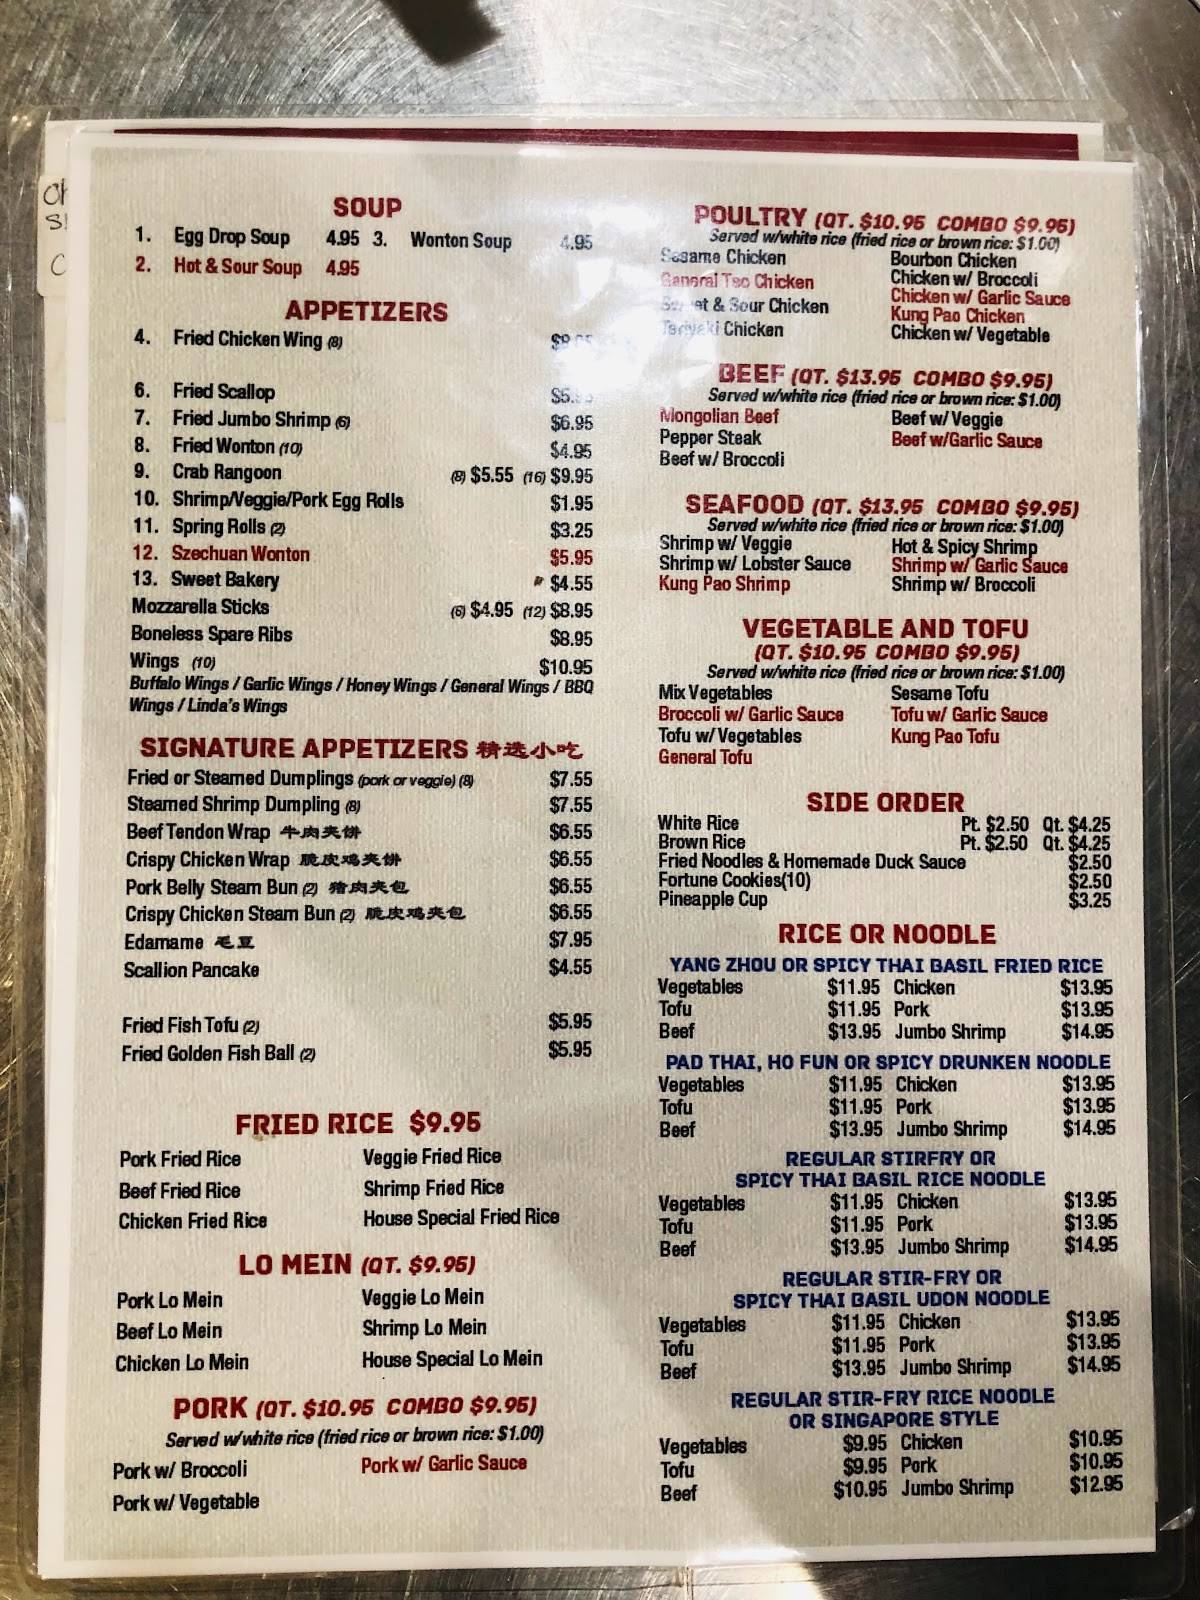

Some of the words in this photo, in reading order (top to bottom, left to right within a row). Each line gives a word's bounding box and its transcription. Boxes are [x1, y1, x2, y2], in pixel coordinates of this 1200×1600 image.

[332, 196, 403, 219] SOUP
[694, 204, 808, 228] POULTRY
[814, 211, 855, 231] (QT.
[859, 211, 927, 232] $10.95
[936, 214, 1009, 233] COMBO
[1012, 215, 1076, 237] $9.95)
[135, 225, 152, 243] 1.
[173, 225, 204, 248] Egg
[208, 226, 247, 249] Drop
[250, 227, 291, 250] Soup
[325, 229, 360, 247] 4.95
[371, 230, 388, 248] 3.
[410, 230, 469, 249] Wonton
[472, 231, 513, 254] Soup
[709, 227, 760, 244] Served
[762, 229, 817, 246] w/white
[819, 232, 848, 246] rice
[850, 231, 889, 251] (fried
[889, 232, 918, 248] rice
[918, 237, 936, 249] or
[937, 233, 982, 250] brown
[983, 235, 1014, 250] rice:
[1015, 235, 1061, 254] $1.00)
[284, 299, 449, 323] APPETIZERS
[133, 408, 151, 426] 7.
[172, 408, 214, 427] Fried
[217, 409, 272, 428] Jumbo
[275, 410, 332, 432] Shrimp
[334, 415, 351, 431] (6)
[550, 413, 594, 433] $6.95
[659, 427, 714, 449] Pepper
[717, 428, 763, 446] Steak
[133, 461, 150, 480] 9.
[172, 462, 210, 480] Crab
[213, 462, 282, 485] Rangoon
[449, 469, 467, 486] (8)
[470, 464, 515, 486] $5.55
[522, 470, 547, 486] (16)
[550, 466, 594, 487] $9.95
[133, 488, 160, 507] 10.
[172, 489, 329, 512] Shrimp/Veggie/Pork
[331, 490, 362, 513] Egg
[365, 491, 405, 510] Rolls
[550, 493, 594, 514] $1.95
[685, 493, 805, 515] SEAFOOD
[811, 497, 852, 518] (QT.
[858, 496, 925, 518] $13.95
[935, 498, 1011, 516] COMBO
[1014, 498, 1080, 521] $9.95)
[132, 543, 159, 561] 12.
[171, 543, 248, 562] Szechuan
[250, 544, 311, 563] Wonton
[549, 547, 594, 569] $5.95
[659, 553, 715, 573] Shrimp
[716, 554, 739, 572] w/
[742, 554, 802, 572] Lobster
[803, 554, 852, 572] Sauce
[131, 596, 218, 615] Mozzarella
[220, 597, 270, 616] Sticks
[741, 617, 895, 639] VEGETABLE
[899, 617, 955, 639] AND
[961, 617, 1029, 640] TOFU
[658, 683, 687, 701] Mix
[687, 683, 773, 705] Vegetables
[889, 705, 925, 723] Tofu
[926, 705, 949, 723] w/
[952, 705, 997, 723] Garlic
[999, 705, 1049, 724] Sauce
[139, 736, 296, 759] SIGNATURE
[301, 737, 469, 760] APPETIZERS
[474, 740, 585, 761] 精选小吃
[127, 768, 169, 786] Fried
[173, 772, 192, 786] or
[193, 768, 265, 787] Steamed
[269, 768, 355, 791] Dumplings
[356, 773, 391, 790] (pork
[392, 776, 409, 787] or
[409, 773, 457, 790] veggie)
[458, 773, 476, 790] (8)
[549, 768, 593, 791] $7.55
[805, 791, 870, 813] SIDE
[876, 791, 965, 813] ORDER
[126, 823, 165, 841] Beef
[165, 823, 225, 841] Tendon
[227, 822, 271, 844] Wrap
[279, 824, 363, 841] 牛肉夹饼
[549, 821, 593, 843] $6.55
[656, 813, 702, 831] White
[706, 814, 740, 832] Rice
[961, 815, 982, 833] Pt.
[984, 813, 1030, 834] $2.50
[1042, 815, 1065, 835] Qt.
[1067, 814, 1112, 834] $4.25
[658, 870, 719, 888] Fortune
[721, 870, 812, 891] Cookies(10)
[1068, 872, 1113, 891] $2.50
[123, 932, 204, 951] Edamame
[213, 934, 256, 950] 毛豆
[548, 929, 593, 951] $7.95
[778, 922, 843, 945] RICE
[849, 923, 886, 945] OR
[892, 923, 998, 945] NOODLE
[656, 977, 744, 999] Vegetables
[827, 976, 881, 998] $11.95
[893, 978, 956, 996] Chicken
[1060, 977, 1114, 999] $13.95
[665, 1053, 704, 1071] PAD
[708, 1053, 763, 1074] THAI,
[767, 1053, 795, 1071] HO
[799, 1053, 839, 1071] FUN
[843, 1054, 871, 1071] OR
[875, 1053, 934, 1071] SPICY
[938, 1054, 1031, 1071] DRUNKEN
[1036, 1053, 1112, 1070] NOODLE
[235, 1112, 320, 1136] FRIED
[327, 1111, 395, 1135] RICE
[408, 1108, 482, 1137] $9.95
[363, 1209, 414, 1228] House
[417, 1207, 476, 1231] Special
[480, 1207, 521, 1226] Fried
[524, 1207, 561, 1225] Rice
[238, 1253, 274, 1276] LO
[280, 1252, 353, 1277] MEIN
[360, 1255, 402, 1278] (QT.
[407, 1254, 477, 1277] $9.95)
[362, 1318, 420, 1341] Shrimp
[424, 1317, 444, 1337] Lo
[448, 1317, 488, 1337] Mein
[172, 1395, 249, 1421] PORK
[255, 1399, 297, 1422] (QT.
[301, 1397, 376, 1421] $10.95
[385, 1396, 465, 1416] COMBO
[469, 1394, 538, 1417] $9.95)
[730, 1390, 823, 1410] REGULAR
[826, 1389, 922, 1408] STIR-FRY
[926, 1388, 974, 1406] RICE
[979, 1387, 1056, 1405] NOODLE
[788, 1412, 816, 1430] OR
[820, 1411, 935, 1430] SINGAPORE
[939, 1409, 1000, 1427] STYLE
[361, 1455, 400, 1475] Pork
[401, 1454, 425, 1474] w/
[428, 1453, 474, 1473] Garlic
[477, 1453, 528, 1472] Sauce
[660, 1483, 699, 1503] Beef
[833, 1479, 888, 1501] $10.95
[901, 1478, 954, 1497] Jumbo
[958, 1477, 1015, 1500] Shrimp
[1069, 1473, 1124, 1497] $12.95
